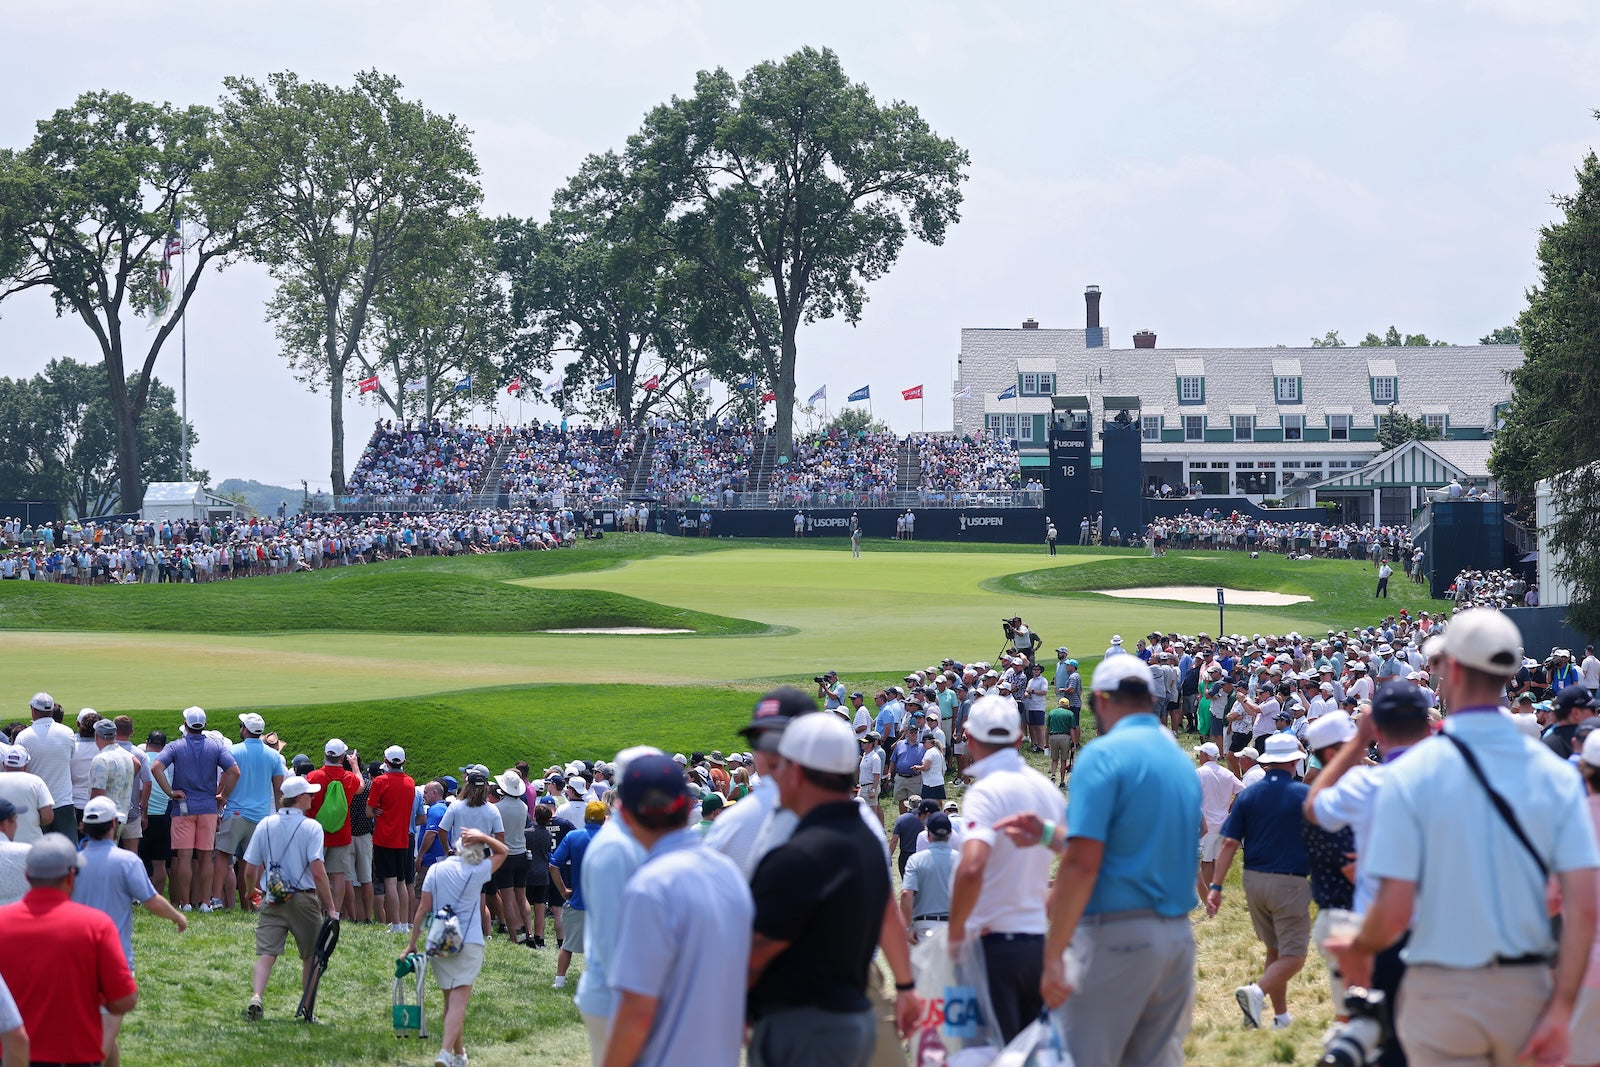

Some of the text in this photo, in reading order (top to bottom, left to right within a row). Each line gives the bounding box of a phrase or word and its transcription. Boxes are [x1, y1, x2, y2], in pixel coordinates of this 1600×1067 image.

[1058, 440, 1085, 448] USOPEN
[1061, 465, 1075, 477] 18
[813, 518, 850, 527] USOPEN
[966, 517, 1004, 526] USOPEN
